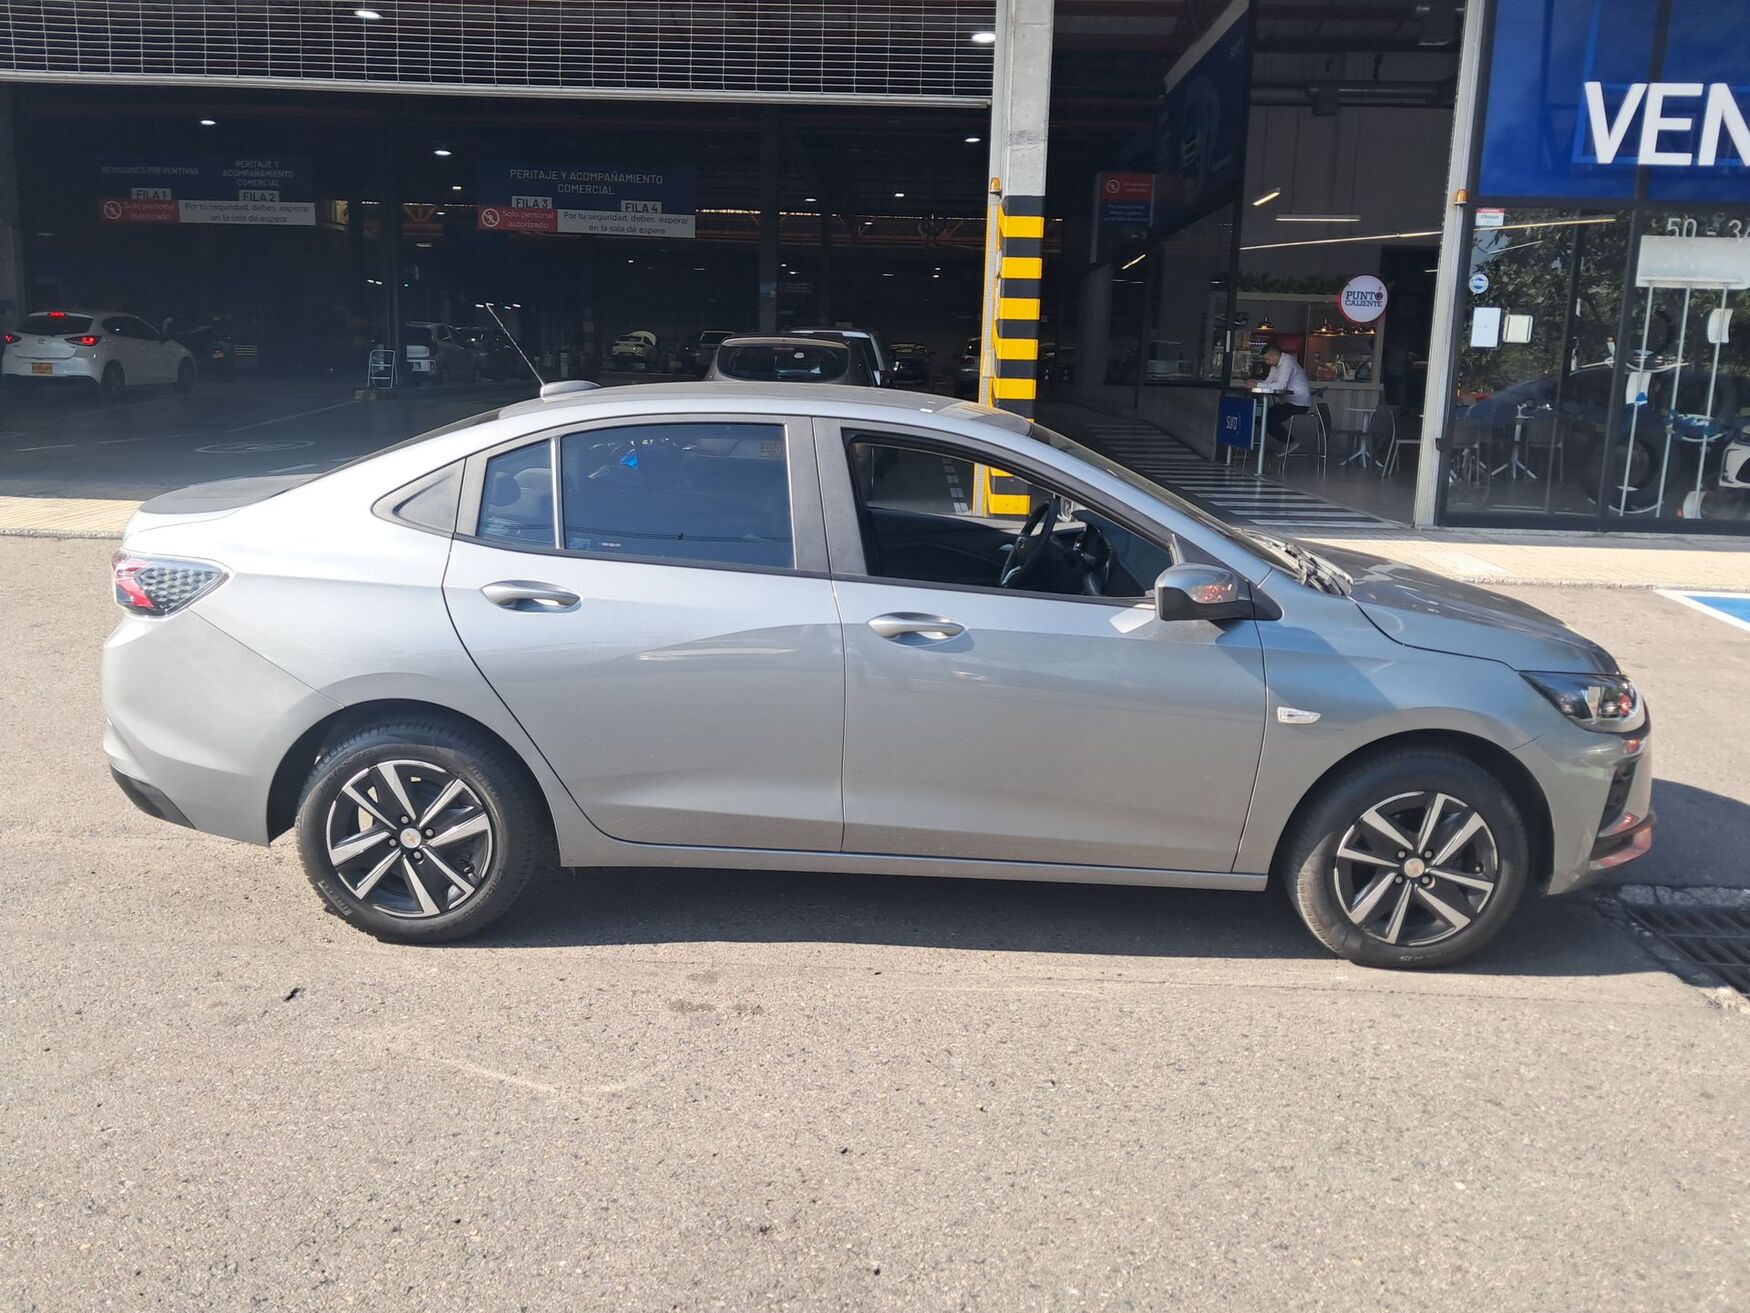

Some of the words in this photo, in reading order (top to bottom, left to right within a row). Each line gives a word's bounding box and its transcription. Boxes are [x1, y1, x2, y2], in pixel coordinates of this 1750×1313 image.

[1585, 81, 1750, 167] VEN
[235, 160, 272, 169] PERITAJE
[274, 161, 279, 169] Y
[101, 166, 146, 176] REVISIONES
[147, 166, 200, 176] PREVENTIVAS
[510, 169, 558, 180] PERITAJE
[561, 171, 567, 180] Y
[569, 170, 663, 184] ACOMPAÑAMIENTO
[236, 178, 280, 187] COMERCIAL
[557, 184, 616, 195] COMERCIAL
[136, 190, 160, 200] FILA
[243, 191, 267, 201] FILA
[269, 192, 276, 201] 2
[184, 202, 197, 210] Por
[516, 198, 539, 208] FILA
[541, 199, 548, 208] 3
[625, 202, 648, 213] FILA
[650, 203, 658, 213] 4
[248, 214, 257, 222] de
[502, 209, 519, 217] Solo
[520, 210, 554, 219] personal
[563, 211, 576, 220] Por
[578, 212, 586, 220] tu
[658, 217, 689, 227] esperar
[509, 220, 549, 229] autorizado
[600, 223, 608, 232] la
[609, 224, 625, 232] sala
[626, 225, 637, 233] de
[639, 226, 666, 236] espera
[1667, 218, 1698, 238] 50
[1346, 291, 1383, 301] PUNTO
